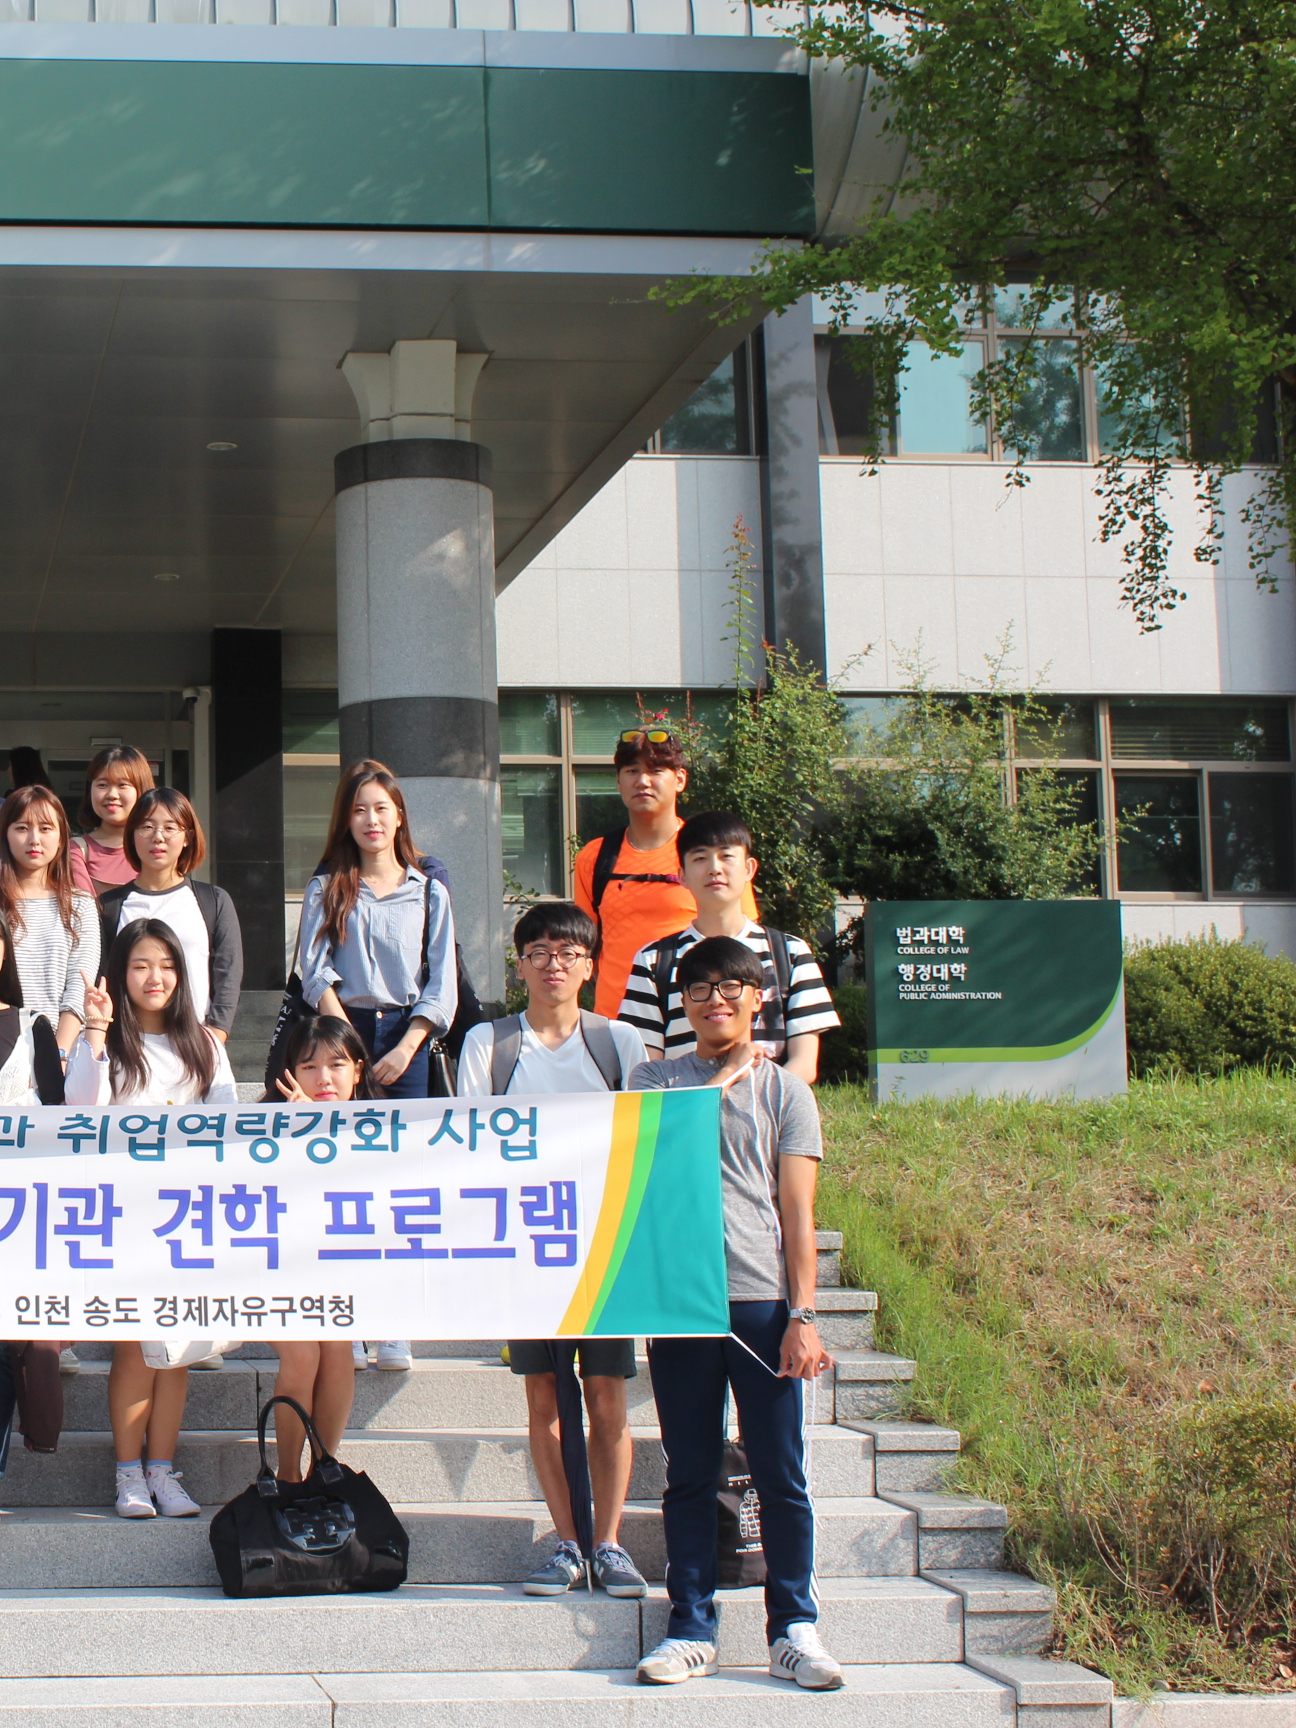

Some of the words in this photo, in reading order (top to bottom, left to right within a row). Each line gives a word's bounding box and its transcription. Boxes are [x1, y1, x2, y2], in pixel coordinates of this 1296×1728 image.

[896, 926, 966, 944] 법과대학
[898, 963, 967, 981] 행정대학
[899, 992, 928, 1000] PUBLIC
[930, 992, 1002, 1000] ADMINISTRATION
[900, 1050, 929, 1063] 629
[57, 1101, 406, 1164] 취업역량강화
[428, 1107, 537, 1161] 사업
[153, 1184, 286, 1269] 견학
[318, 1181, 577, 1267] 프로그램
[16, 1296, 69, 1325] 인천
[84, 1296, 140, 1327] 송도
[154, 1295, 354, 1327] 경제자유구역청
